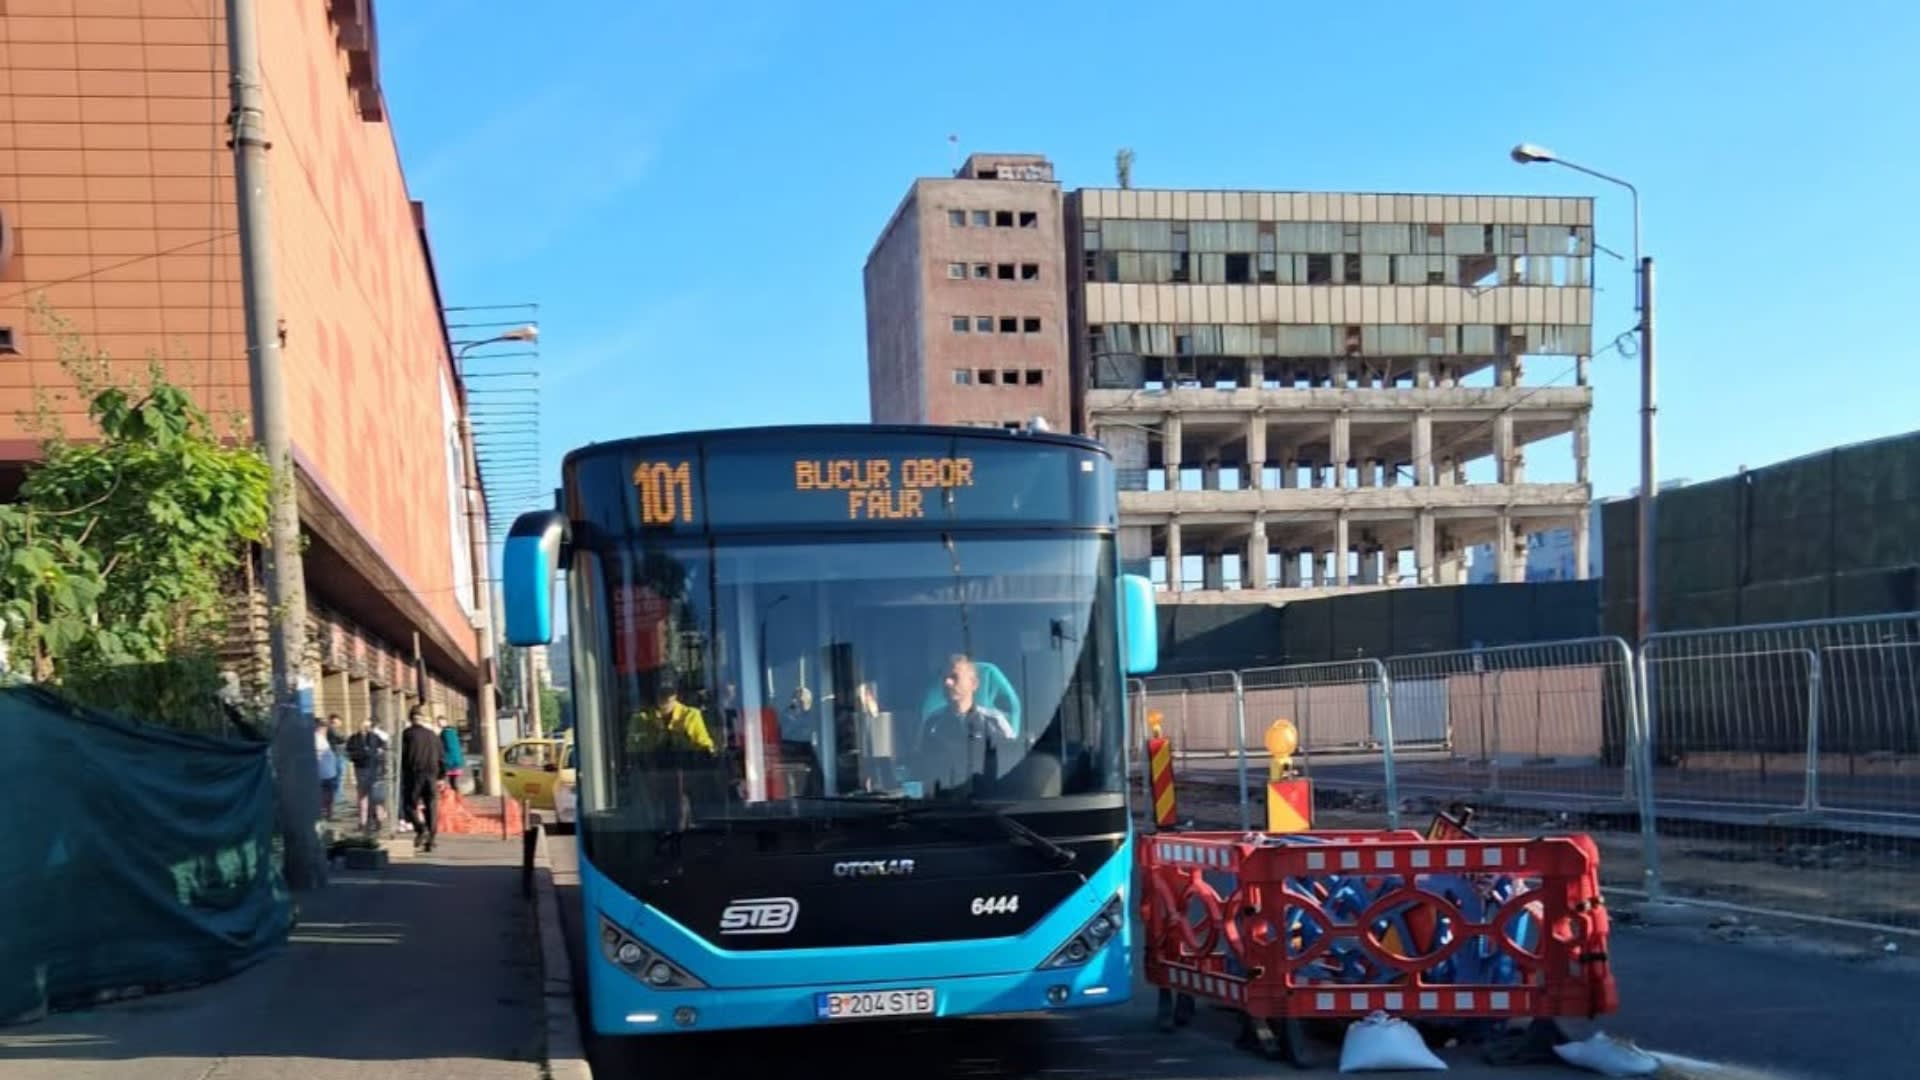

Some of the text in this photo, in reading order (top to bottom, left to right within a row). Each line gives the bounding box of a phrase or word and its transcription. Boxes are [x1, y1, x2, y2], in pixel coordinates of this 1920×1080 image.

[795, 458, 973, 489] BUCUR OBOR
[634, 461, 692, 523] 101
[849, 490, 924, 519] FAUR
[833, 859, 915, 877] OTOKAR
[720, 904, 791, 928] STB
[971, 895, 1019, 915] 6444
[851, 994, 885, 1014] 204
[889, 992, 930, 1011] STB
